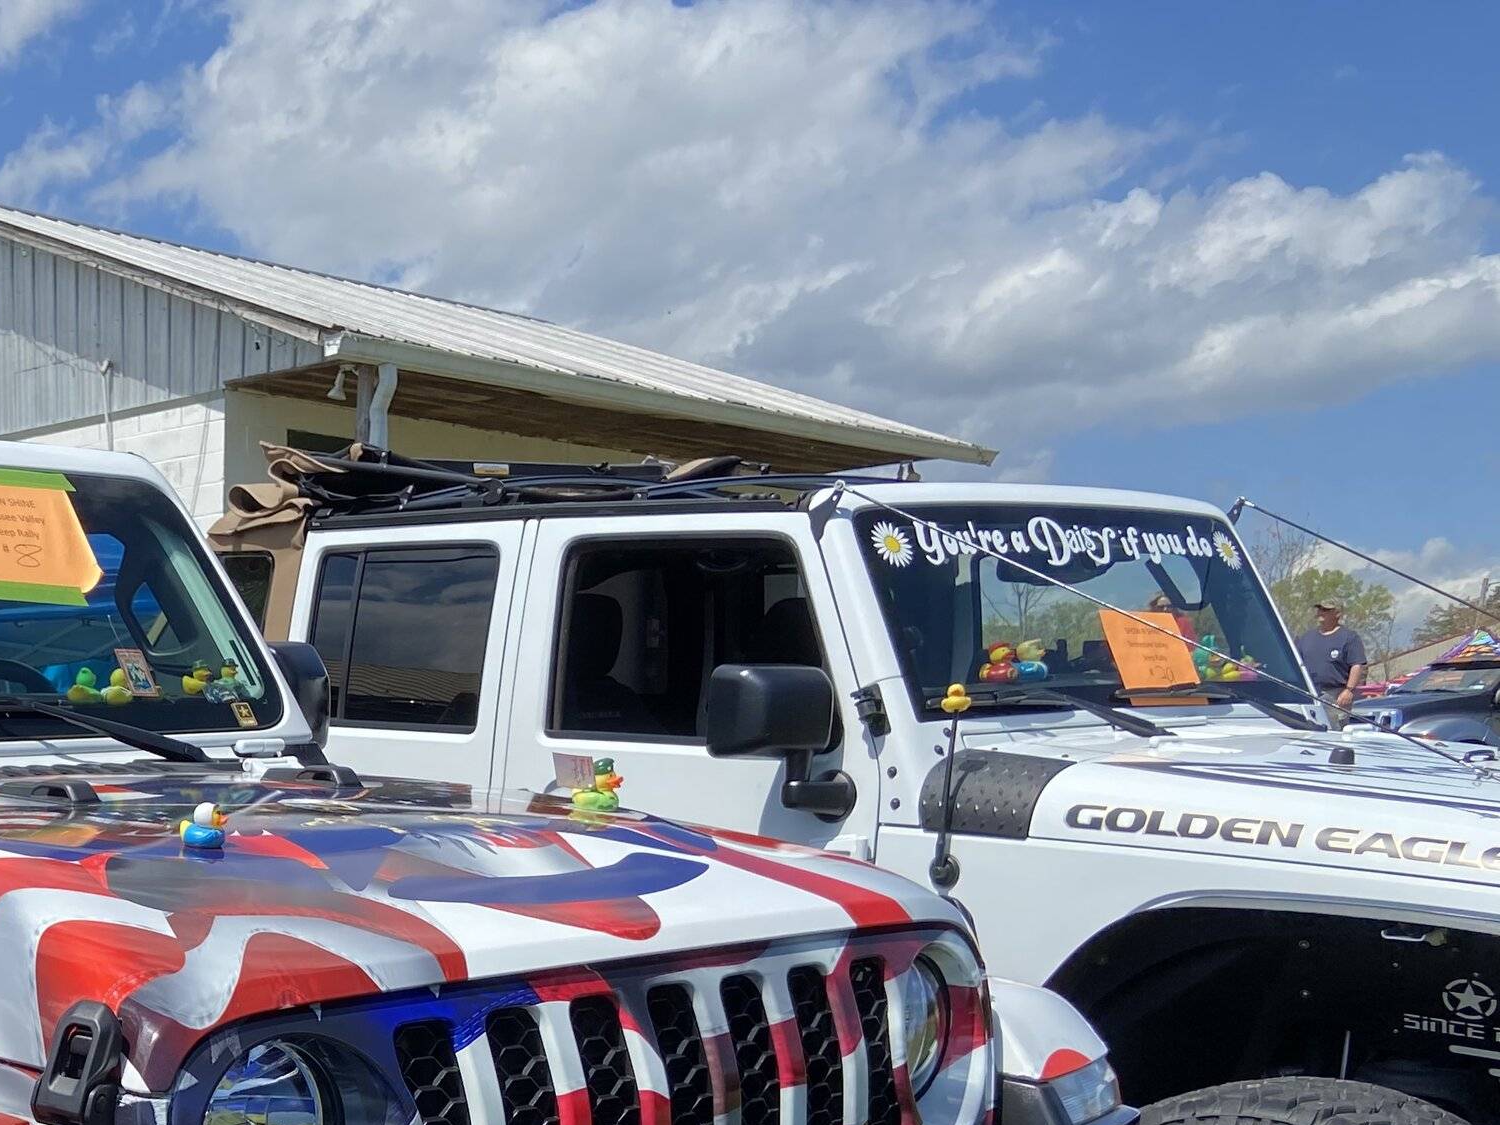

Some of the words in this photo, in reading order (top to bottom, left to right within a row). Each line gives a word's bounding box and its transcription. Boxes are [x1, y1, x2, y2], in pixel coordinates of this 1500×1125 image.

[7, 498, 36, 508] SHINE
[18, 514, 46, 525] Valley
[17, 529, 39, 540] Rally
[912, 520, 1008, 565] You're
[1010, 530, 1030, 553] a
[1117, 526, 1138, 560] if
[1141, 532, 1186, 564] you
[1186, 525, 1213, 557] do
[1065, 803, 1304, 848] GOLDEN
[1403, 1013, 1485, 1040] SINCE
